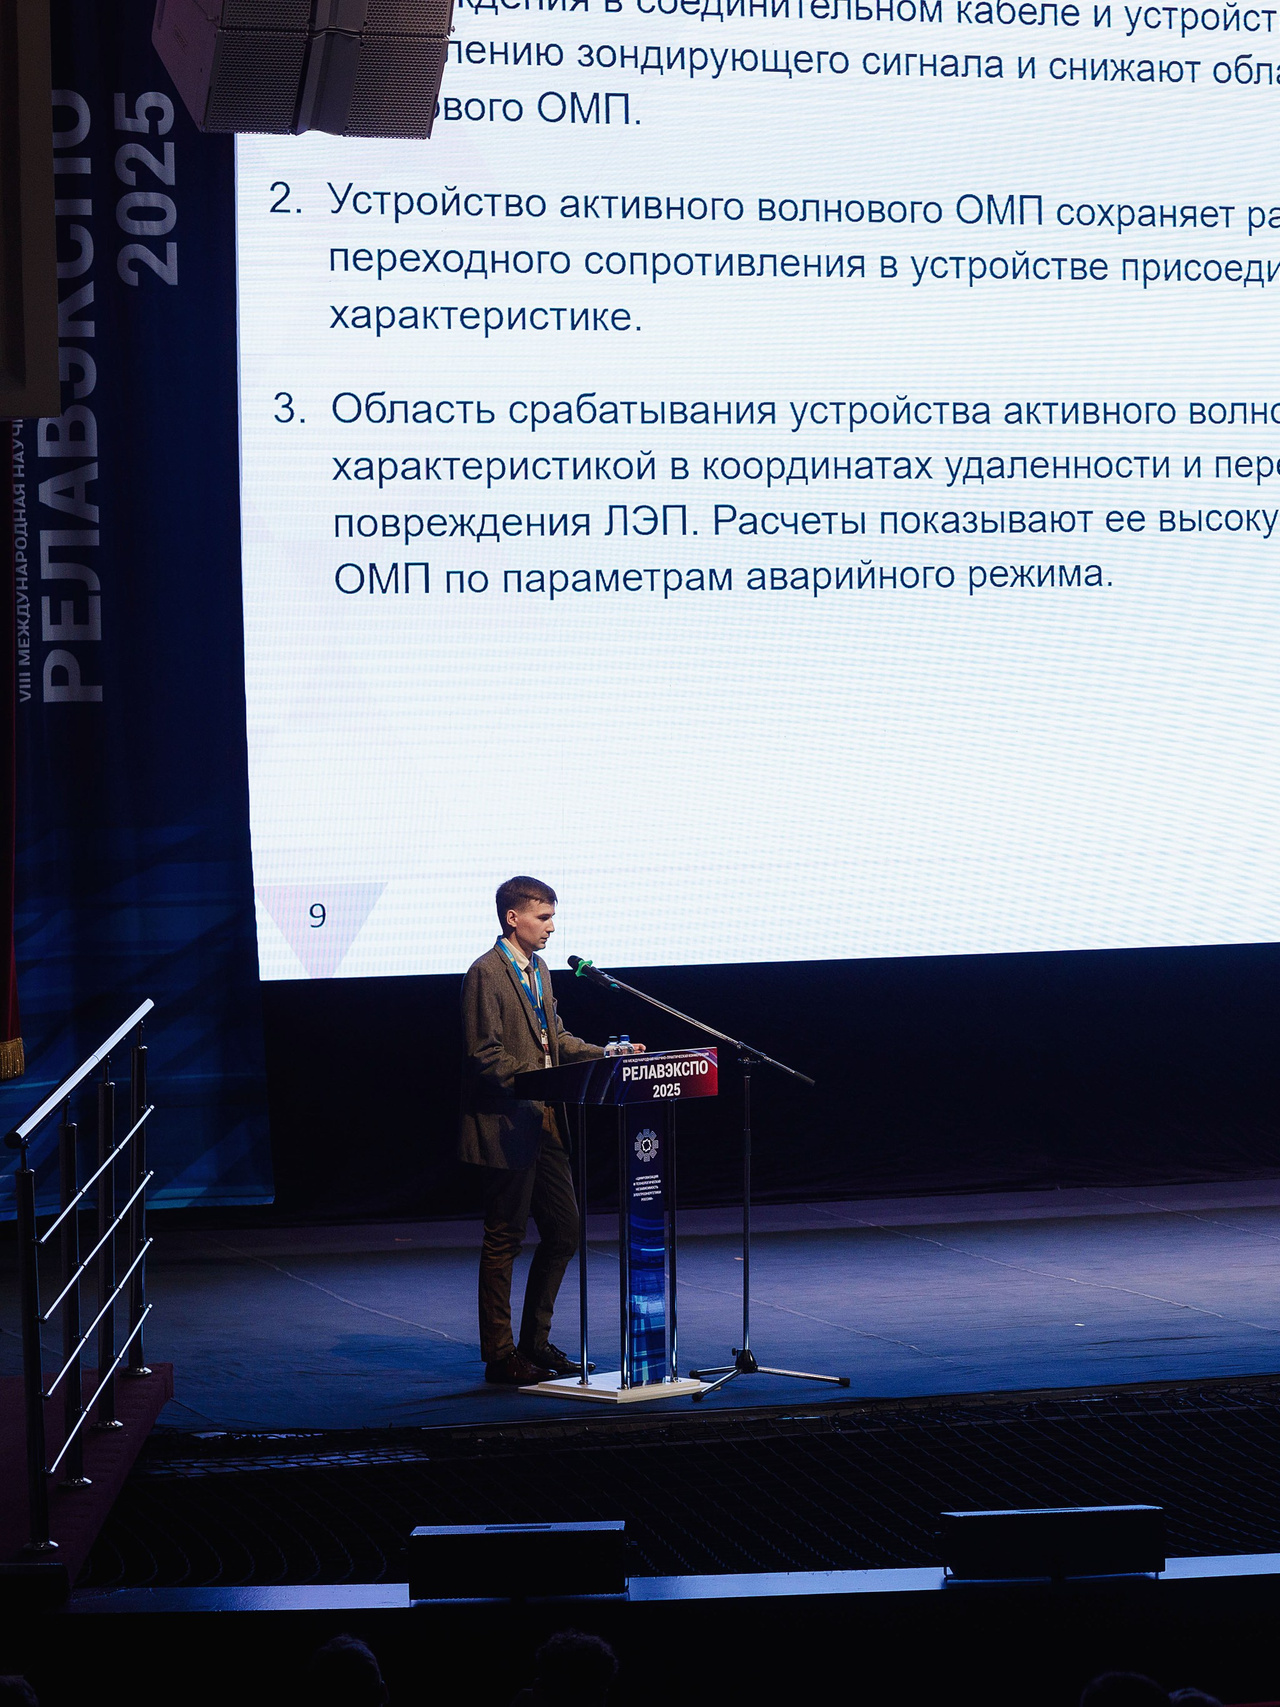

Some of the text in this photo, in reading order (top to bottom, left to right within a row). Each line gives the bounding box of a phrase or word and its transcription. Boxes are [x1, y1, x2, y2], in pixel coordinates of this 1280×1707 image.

[636, 0, 943, 23] соединительном
[957, 0, 1081, 27] кабеле
[1093, 4, 1112, 28] и
[445, 40, 564, 67] лению
[577, 43, 850, 80] зондирующего
[862, 52, 1004, 79] сигнала
[1017, 56, 1036, 80] и
[1049, 57, 1202, 84] снижают
[537, 90, 641, 125] ОМП.
[113, 91, 179, 286] 2025
[269, 181, 302, 214] 2.
[326, 181, 547, 224] Устройство
[559, 194, 745, 221] активного
[758, 197, 943, 224] волнового
[955, 193, 1043, 226] ОМП
[1056, 203, 1236, 235] сохраняет
[329, 247, 571, 281] переходного
[584, 251, 865, 284] сопротивления
[880, 255, 898, 279] в
[910, 249, 1109, 288] устройстве
[329, 305, 641, 339] характеристике.
[274, 391, 306, 424] 3.
[331, 390, 496, 424] Область
[509, 391, 776, 433] срабатывания
[789, 394, 991, 433] устройства
[1003, 401, 1177, 425] активного
[331, 449, 656, 490] характеристикой
[670, 456, 690, 480] в
[703, 456, 934, 489] координатах
[944, 455, 1170, 488] удаленности
[1183, 455, 1202, 479] и
[334, 513, 590, 546] повреждения
[604, 504, 698, 537] ЛЭП.
[713, 503, 866, 536] Расчеты
[880, 510, 1094, 535] показывают
[1105, 509, 1146, 533] ее
[12, 419, 32, 703] VIII МЕЖДУНАРОДНАЯ НАУЧ
[334, 559, 1113, 601] ОМП по параметрам аварийного режима.
[309, 902, 327, 929] 9
[622, 1060, 709, 1082] РЕЛАВЭКСПО
[652, 1083, 681, 1098] 2025
